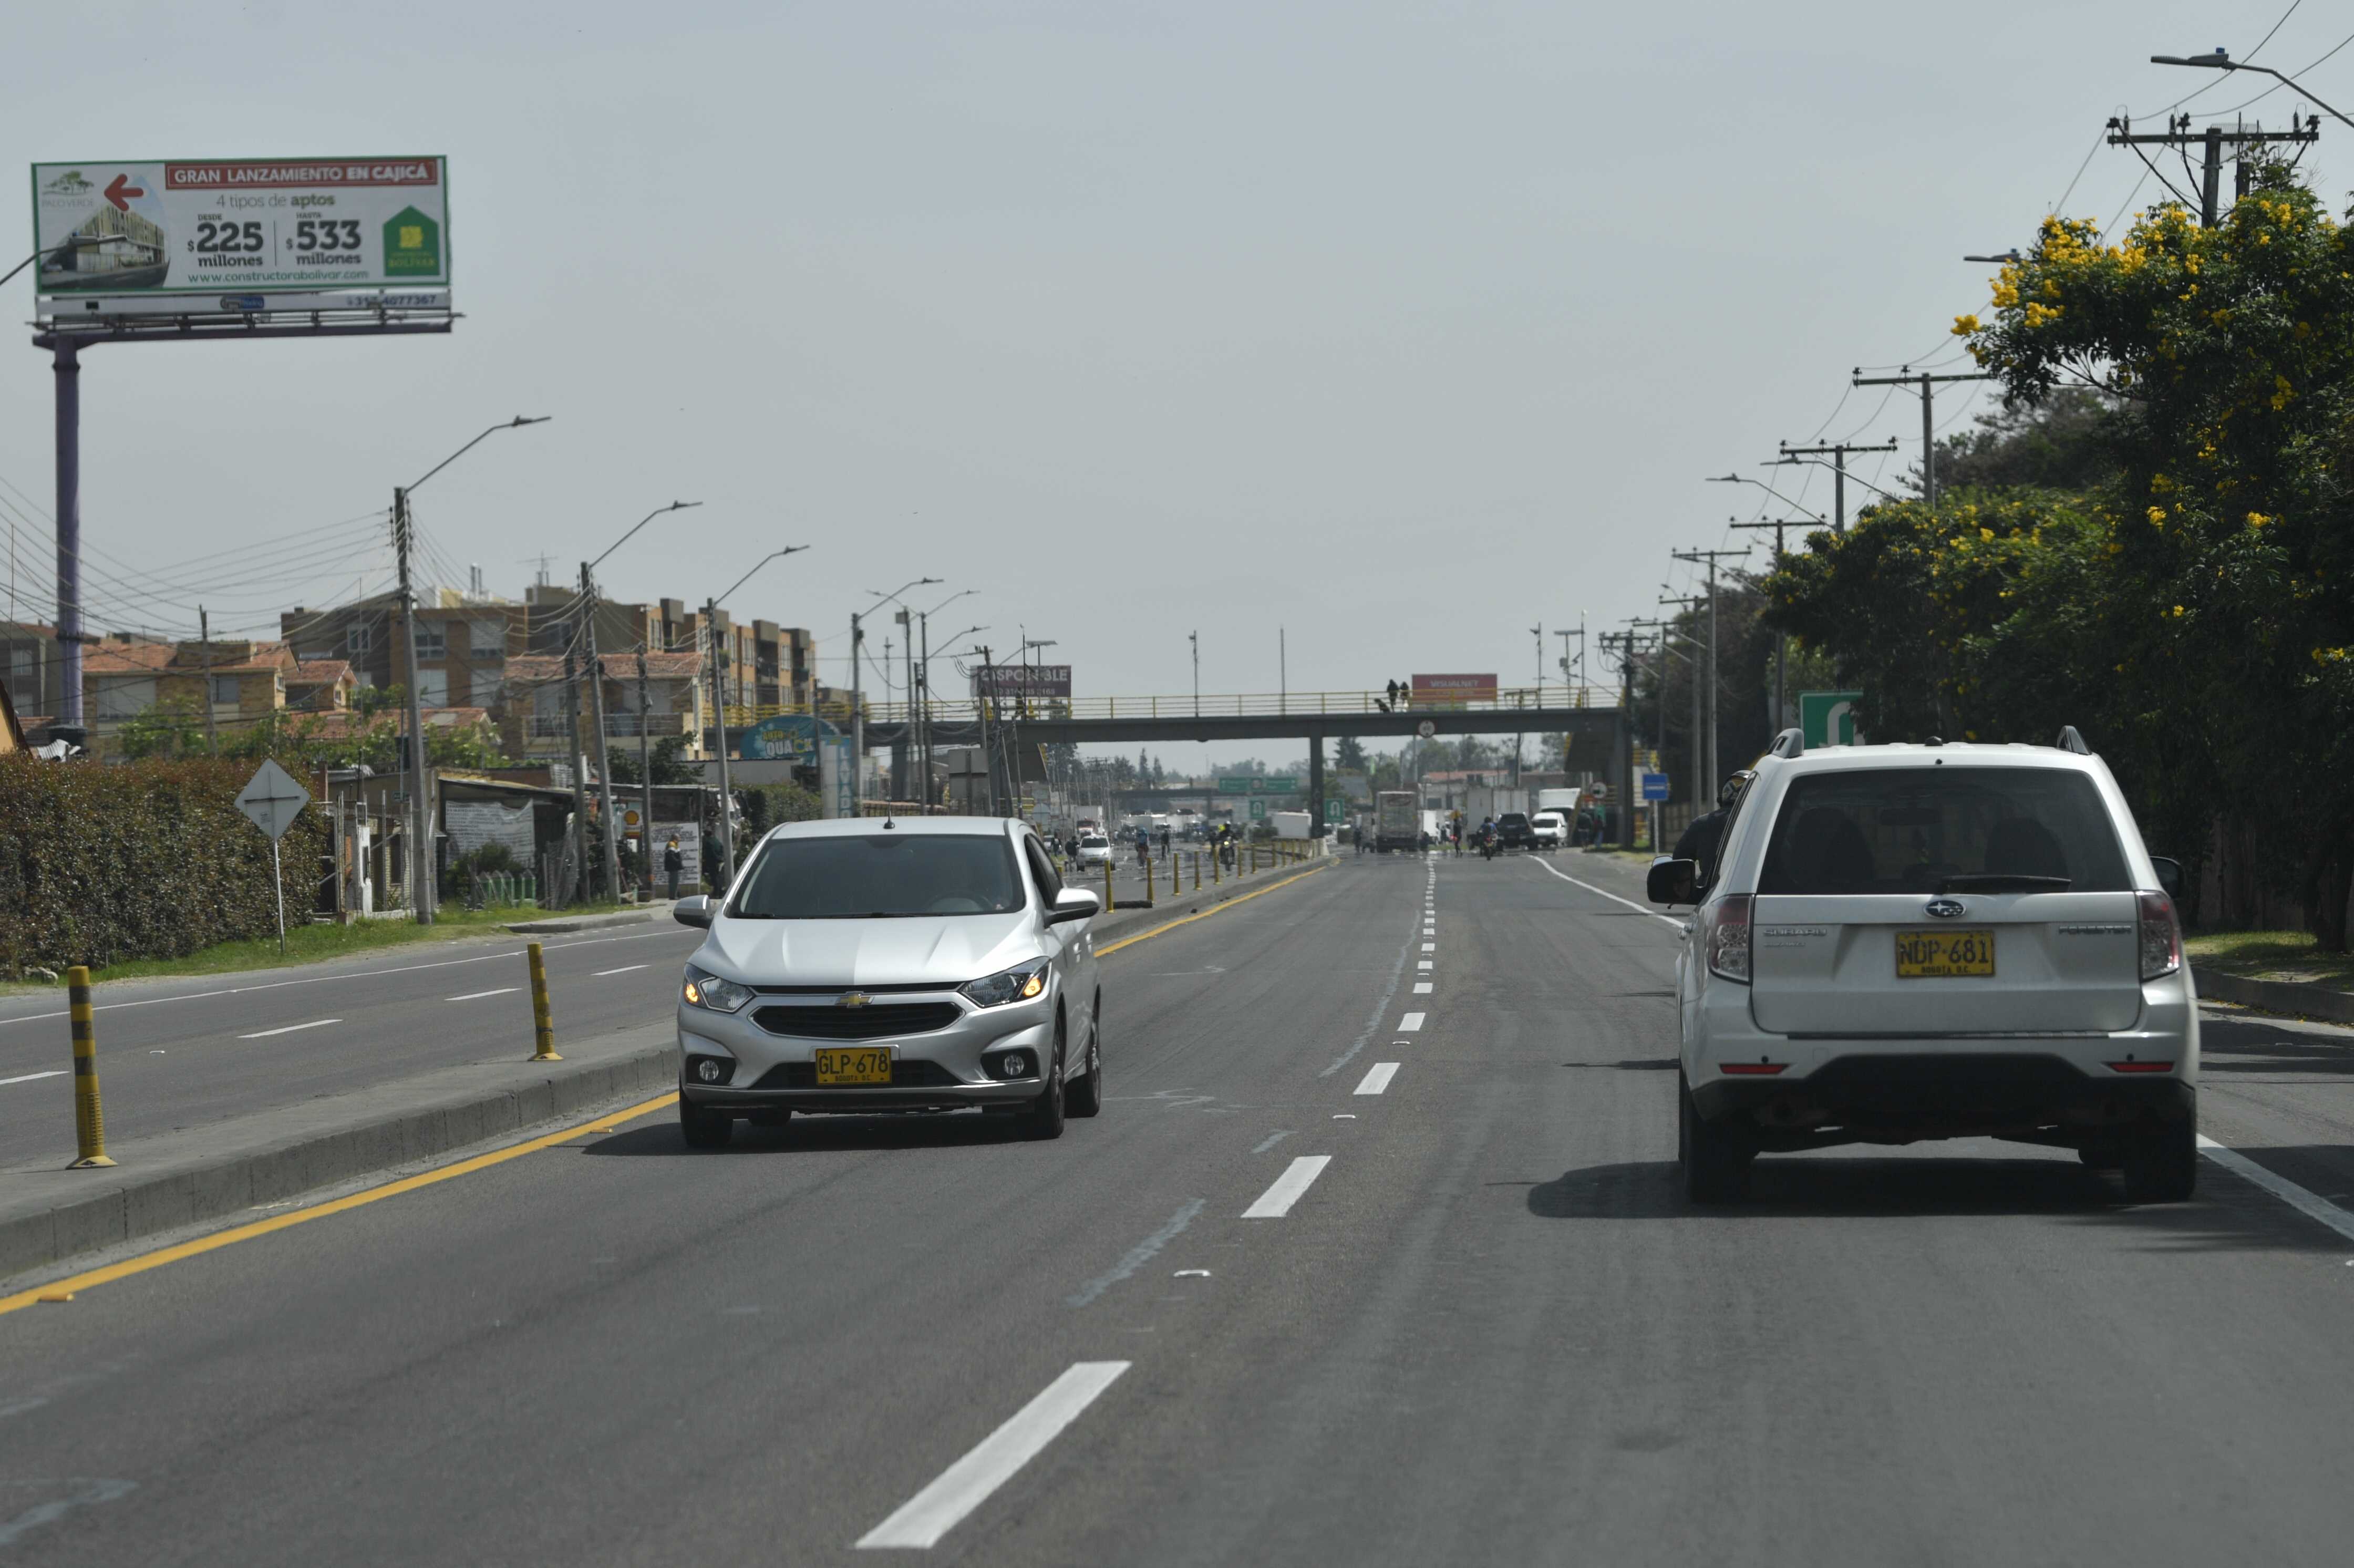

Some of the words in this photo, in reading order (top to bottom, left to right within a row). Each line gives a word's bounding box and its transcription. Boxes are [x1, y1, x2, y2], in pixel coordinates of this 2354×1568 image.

[174, 169, 220, 183] GRAN
[228, 167, 342, 182] LANZAMIENTO
[346, 167, 369, 180] EN
[371, 163, 428, 182] CAJICÁ
[216, 194, 225, 207] 4
[230, 194, 264, 211] tipos
[268, 193, 286, 207] de
[291, 193, 335, 209] aptos
[198, 254, 263, 267] millones
[296, 252, 362, 265] millones
[188, 270, 369, 283] www.constructorabolivar.com
[763, 729, 784, 741] AUTO
[766, 737, 815, 757] QUACK
